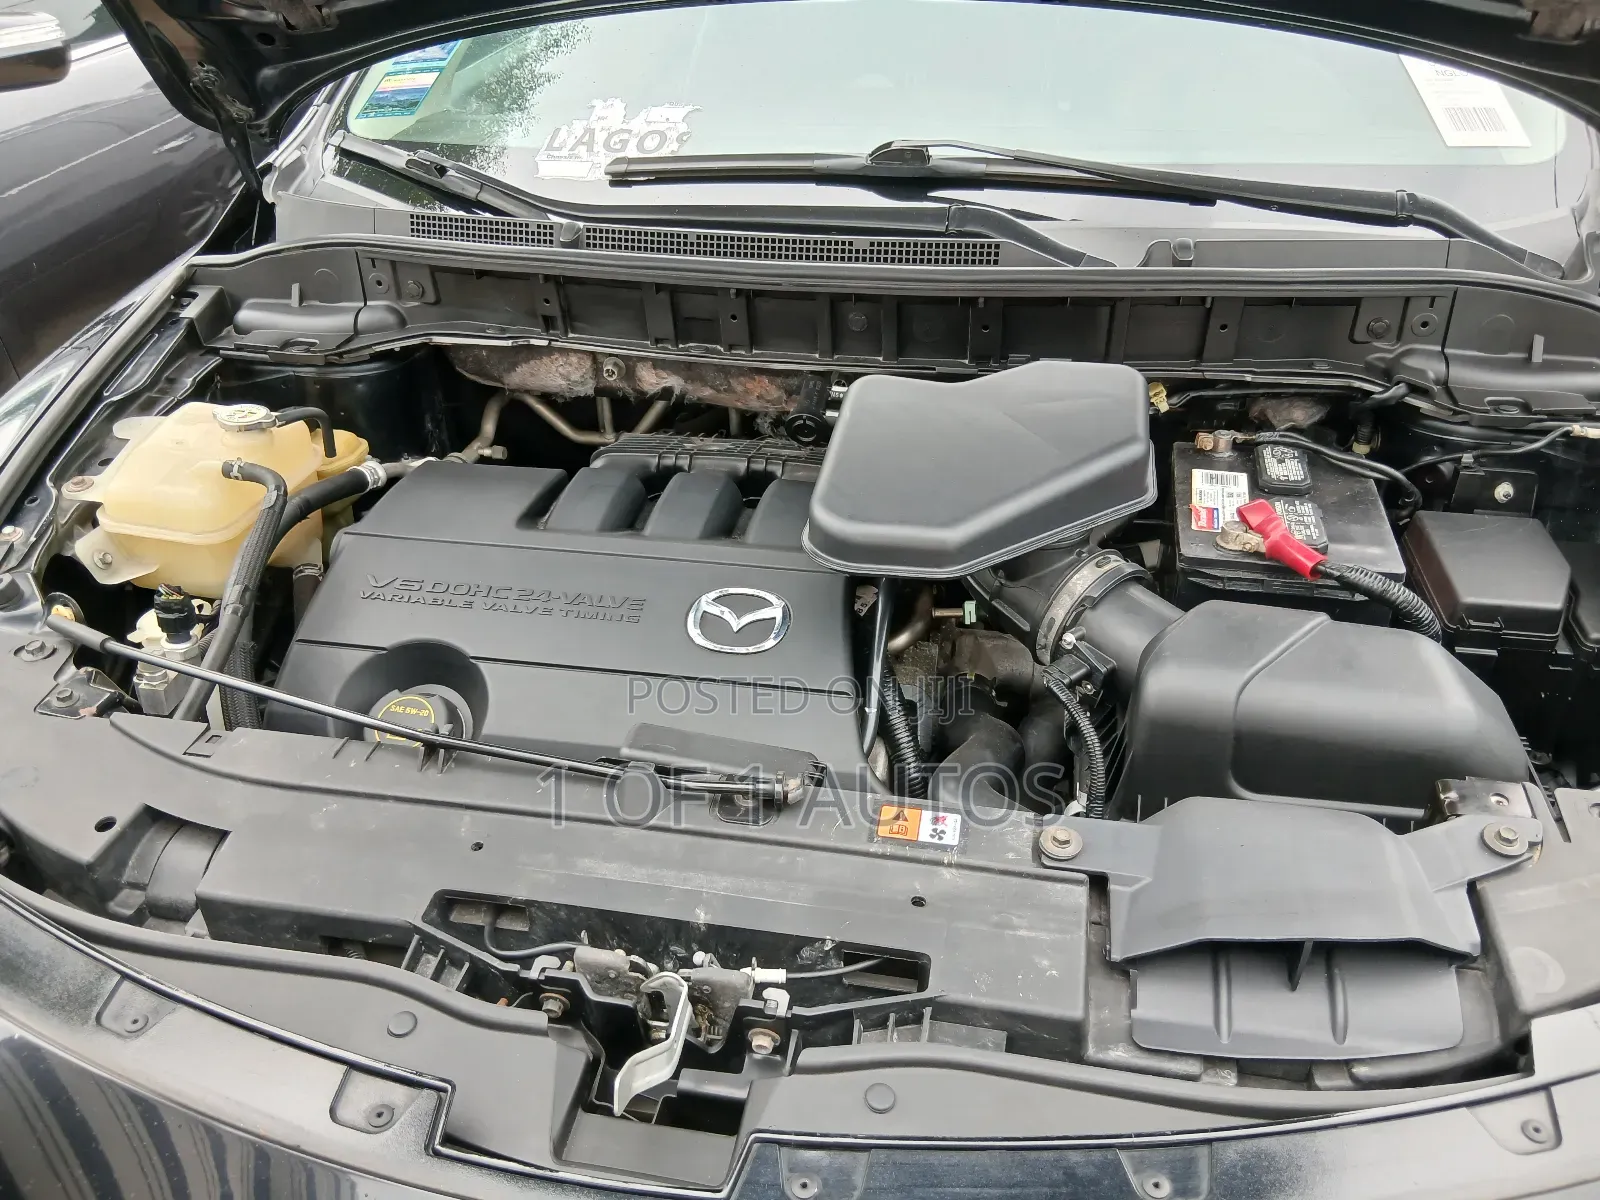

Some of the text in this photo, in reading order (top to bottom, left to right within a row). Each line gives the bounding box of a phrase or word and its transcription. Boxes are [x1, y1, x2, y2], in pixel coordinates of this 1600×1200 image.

[361, 590, 641, 624] VARIABLE VALVE TIMING
[366, 573, 646, 611] V6 DOHC 24-VALVE
[390, 704, 430, 717] SAE 5W-20
